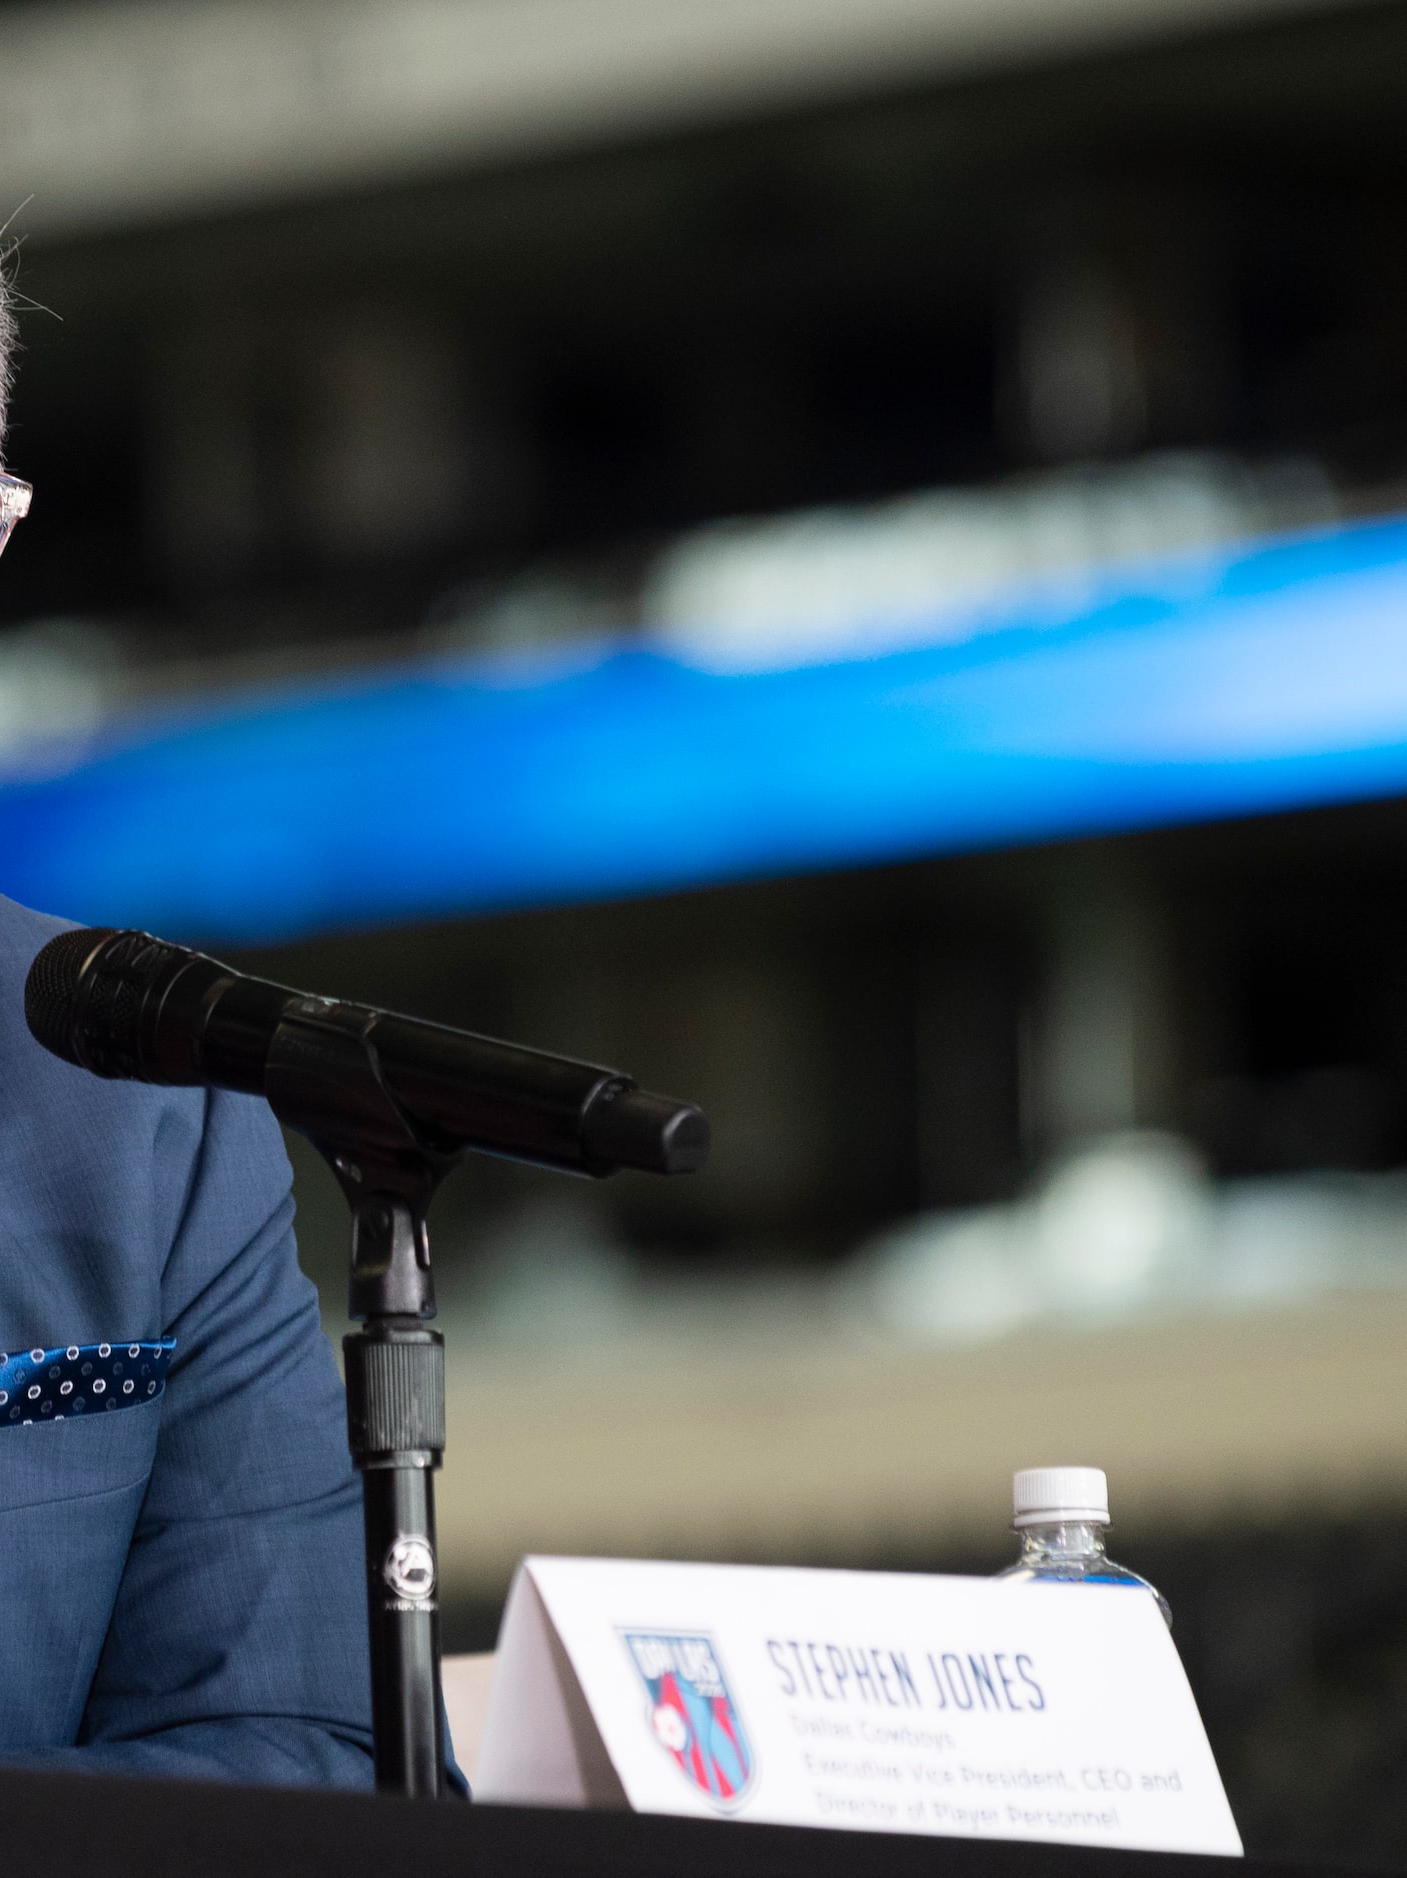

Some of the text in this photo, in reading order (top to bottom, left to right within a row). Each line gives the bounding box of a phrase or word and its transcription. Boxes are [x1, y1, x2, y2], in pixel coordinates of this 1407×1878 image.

[766, 1638, 1046, 1711] STEPHEN JONES
[792, 1714, 955, 1752] Dallas Cowboys
[803, 1752, 1182, 1793] Executive Vice President, CEO and
[816, 1791, 1120, 1831] Director of Player Personnel
